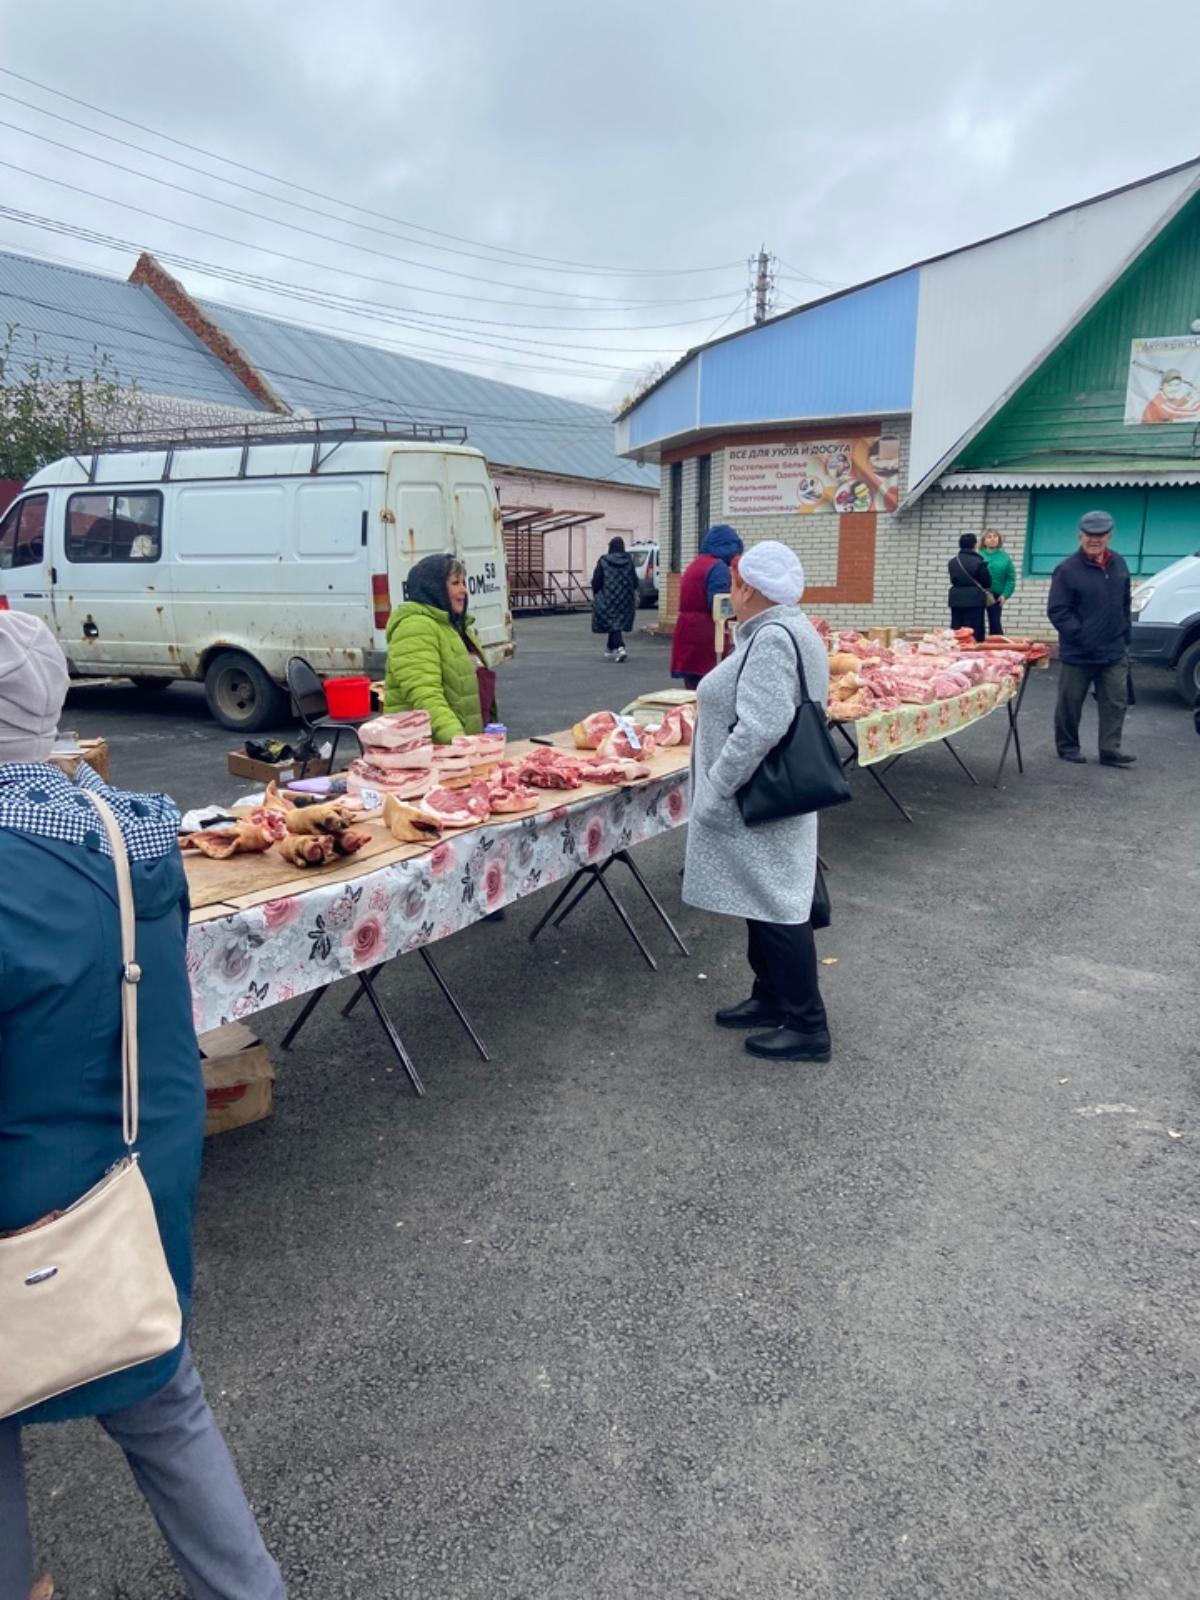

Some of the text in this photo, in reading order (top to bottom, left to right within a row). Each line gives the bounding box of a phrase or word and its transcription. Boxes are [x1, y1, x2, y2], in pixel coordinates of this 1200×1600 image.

[748, 448, 769, 459] ДЛЯ
[771, 447, 799, 457] УЮТА
[801, 446, 809, 455] И
[811, 444, 850, 455] ДОСУГА
[729, 462, 780, 472] Постельное
[729, 471, 807, 482] Подушки Одеяла
[728, 484, 777, 492] Купальники
[728, 494, 782, 503] Спорттовары
[485, 562, 496, 579] 58
